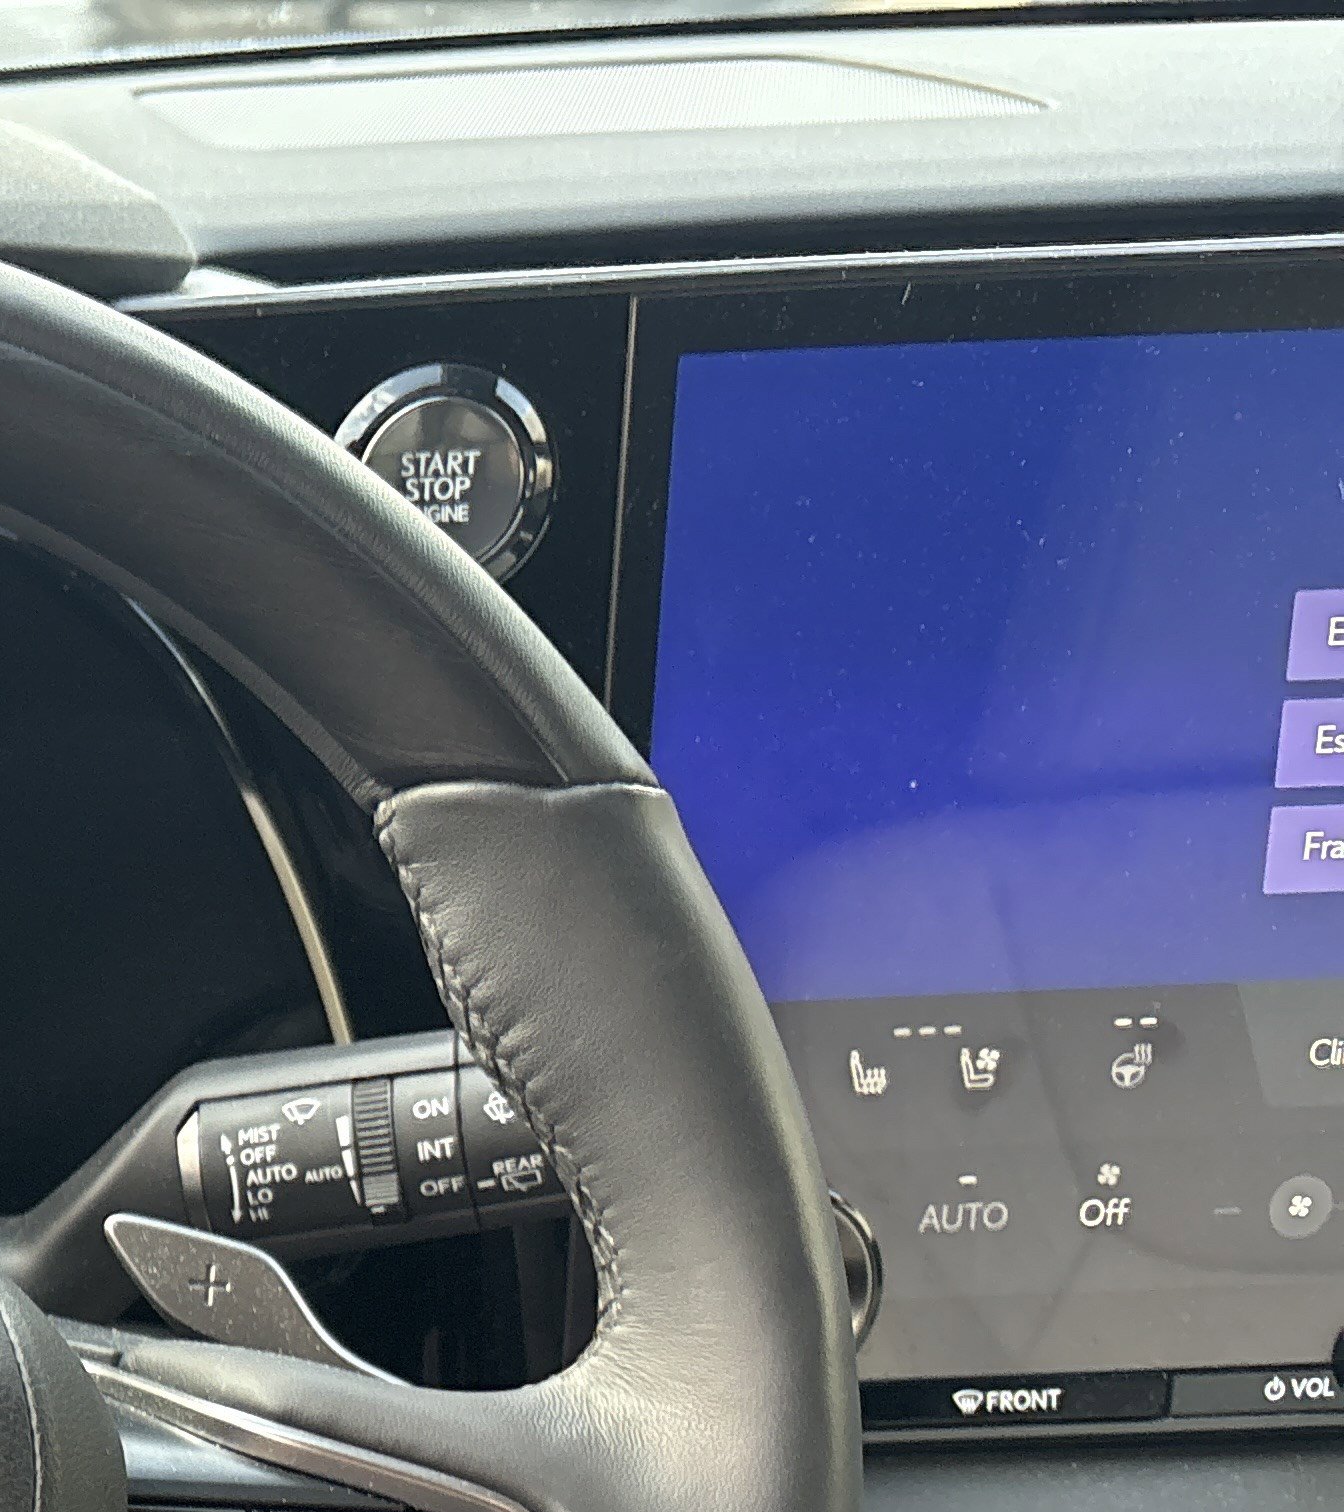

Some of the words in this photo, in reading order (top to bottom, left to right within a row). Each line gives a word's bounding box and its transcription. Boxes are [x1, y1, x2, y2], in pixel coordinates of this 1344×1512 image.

[400, 450, 482, 477] START
[404, 477, 472, 501] STOP
[412, 1096, 450, 1120] ON
[238, 1123, 280, 1146] MIST
[240, 1144, 276, 1166] OFF
[417, 1136, 454, 1163] INT
[247, 1162, 298, 1187] AUTO
[304, 1164, 343, 1184] AUTO
[492, 1153, 544, 1178] REAR
[247, 1186, 273, 1206] LO
[419, 1175, 465, 1197] OFF
[918, 1202, 1008, 1234] AUTO
[1079, 1197, 1131, 1229] Off
[986, 1390, 1062, 1412] FRONT
[1291, 1379, 1334, 1400] VOL
